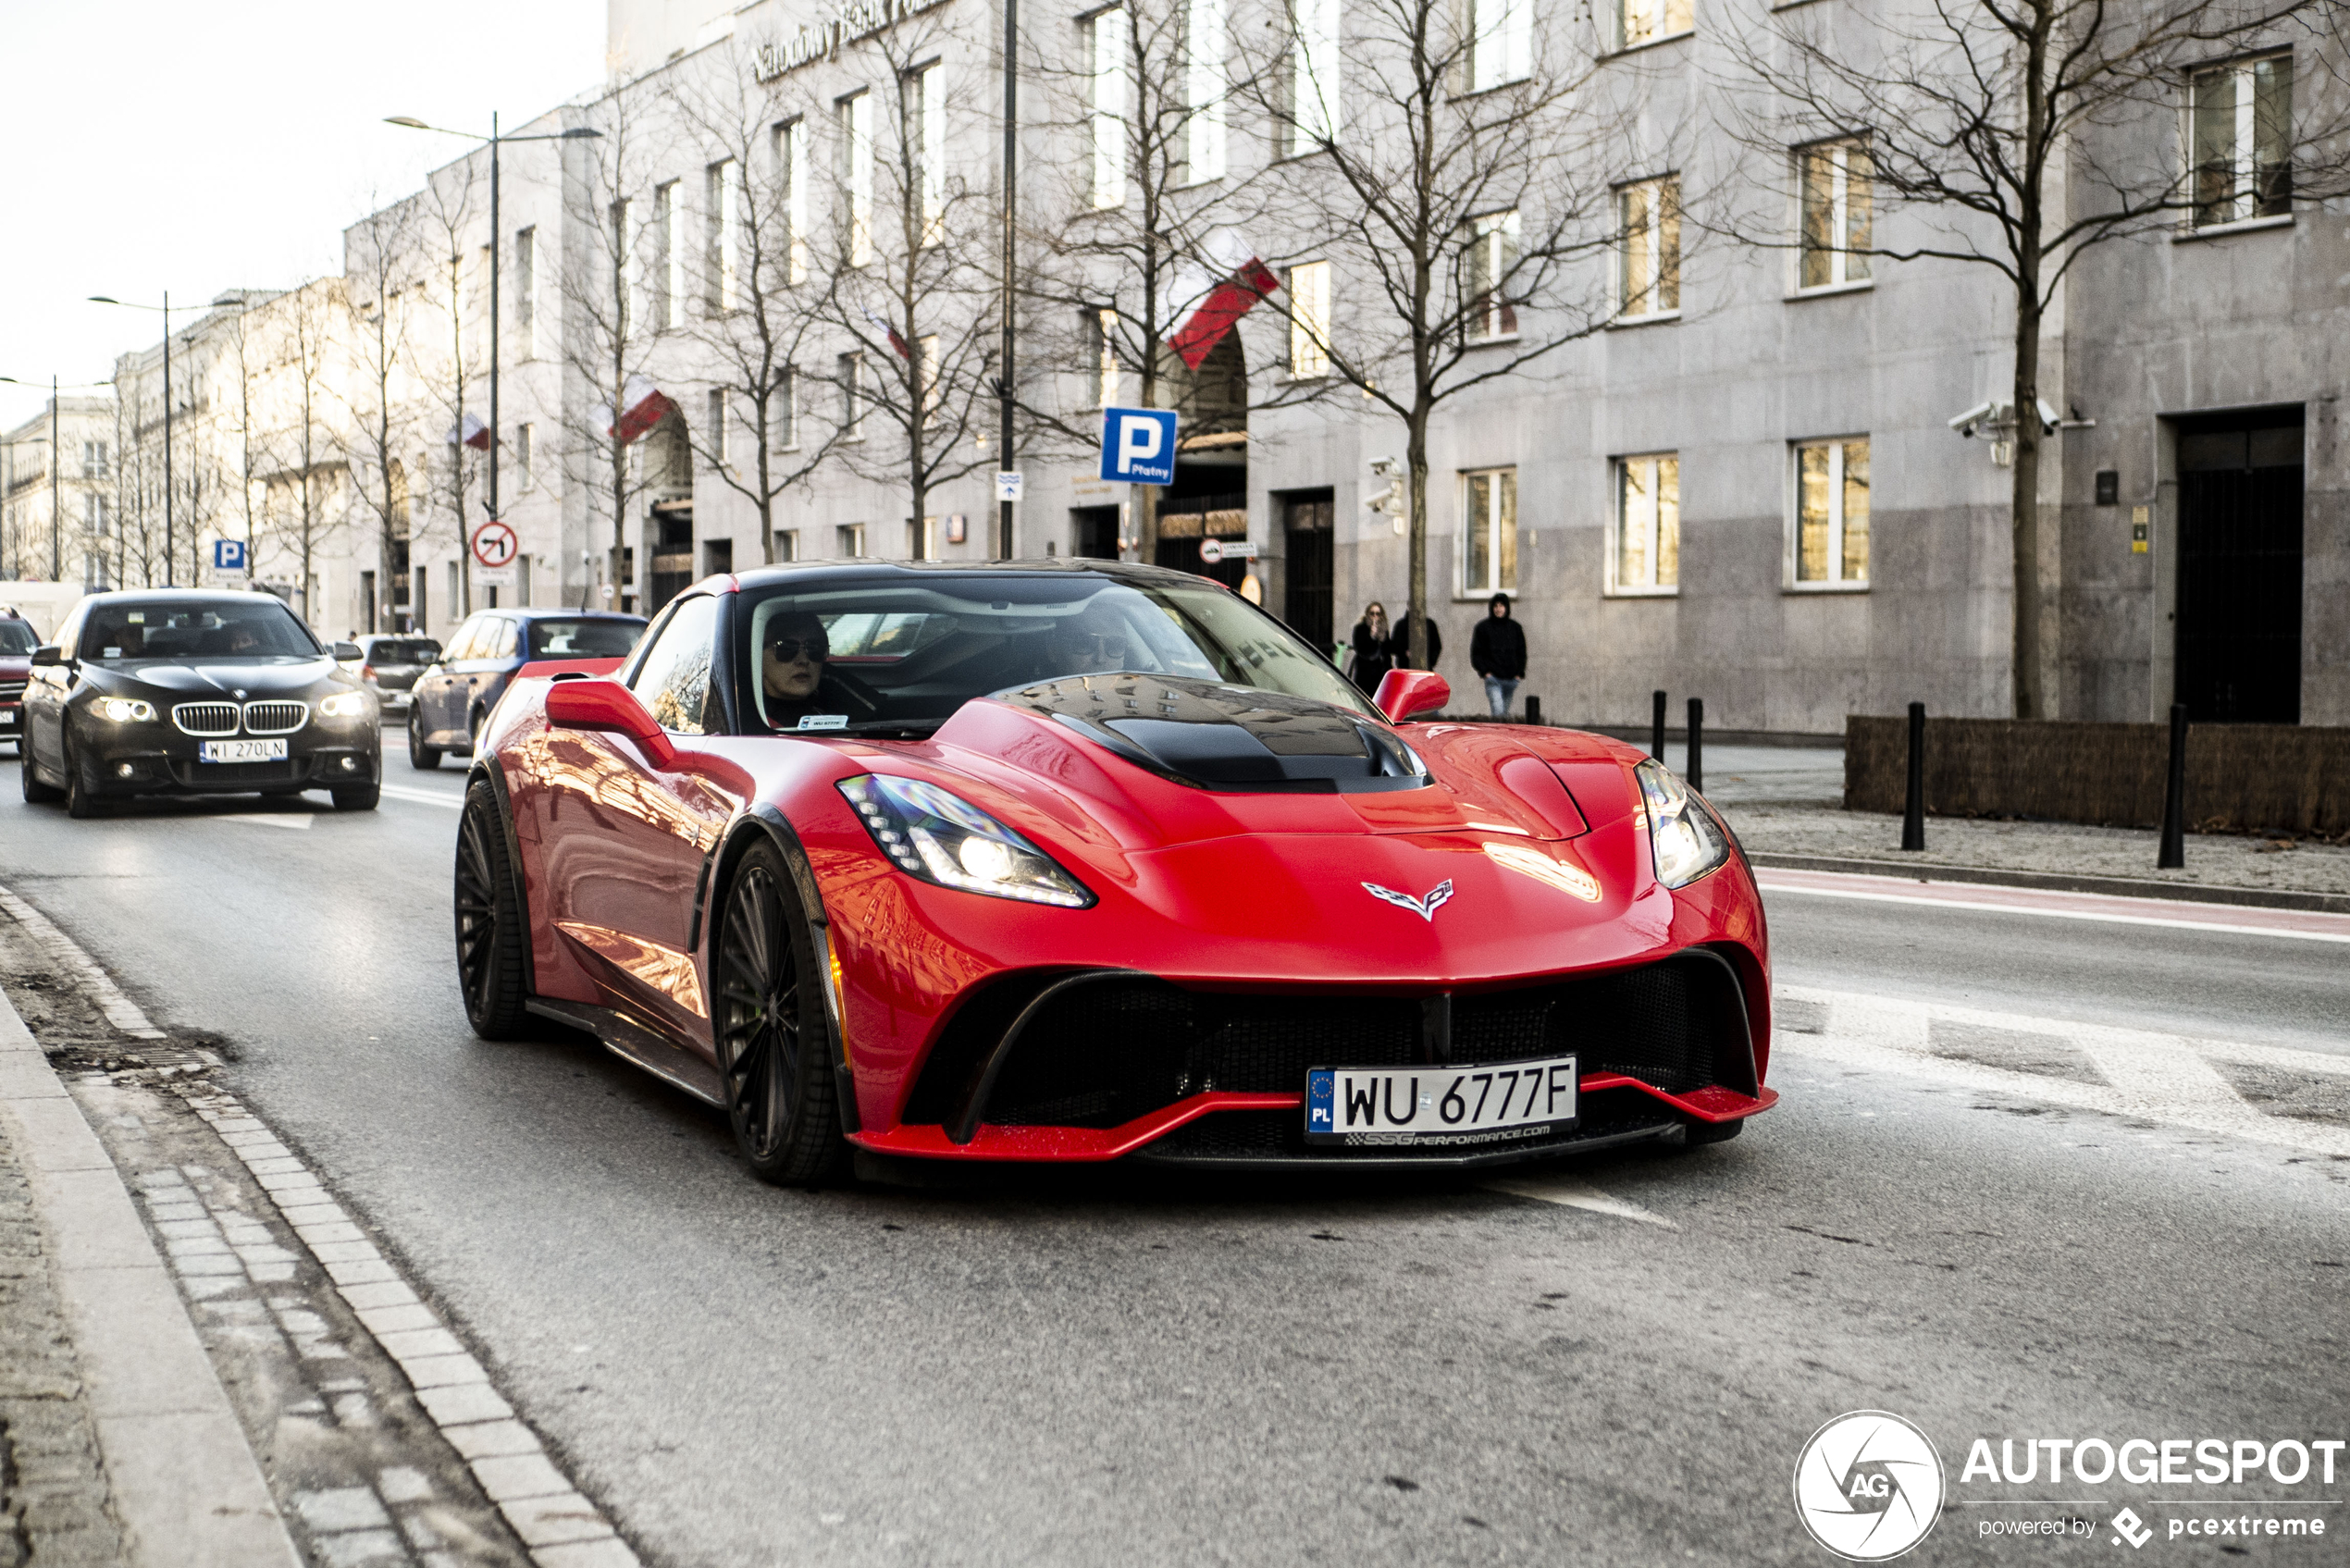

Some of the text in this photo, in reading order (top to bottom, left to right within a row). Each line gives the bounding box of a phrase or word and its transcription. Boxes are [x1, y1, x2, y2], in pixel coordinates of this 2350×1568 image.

[751, 23, 835, 83] Narodowy
[1117, 414, 1163, 474] P
[221, 543, 240, 566] P
[210, 742, 282, 758] WI 270LN
[1312, 1108, 1330, 1122] PL
[1344, 1065, 1570, 1126] WU 6777F
